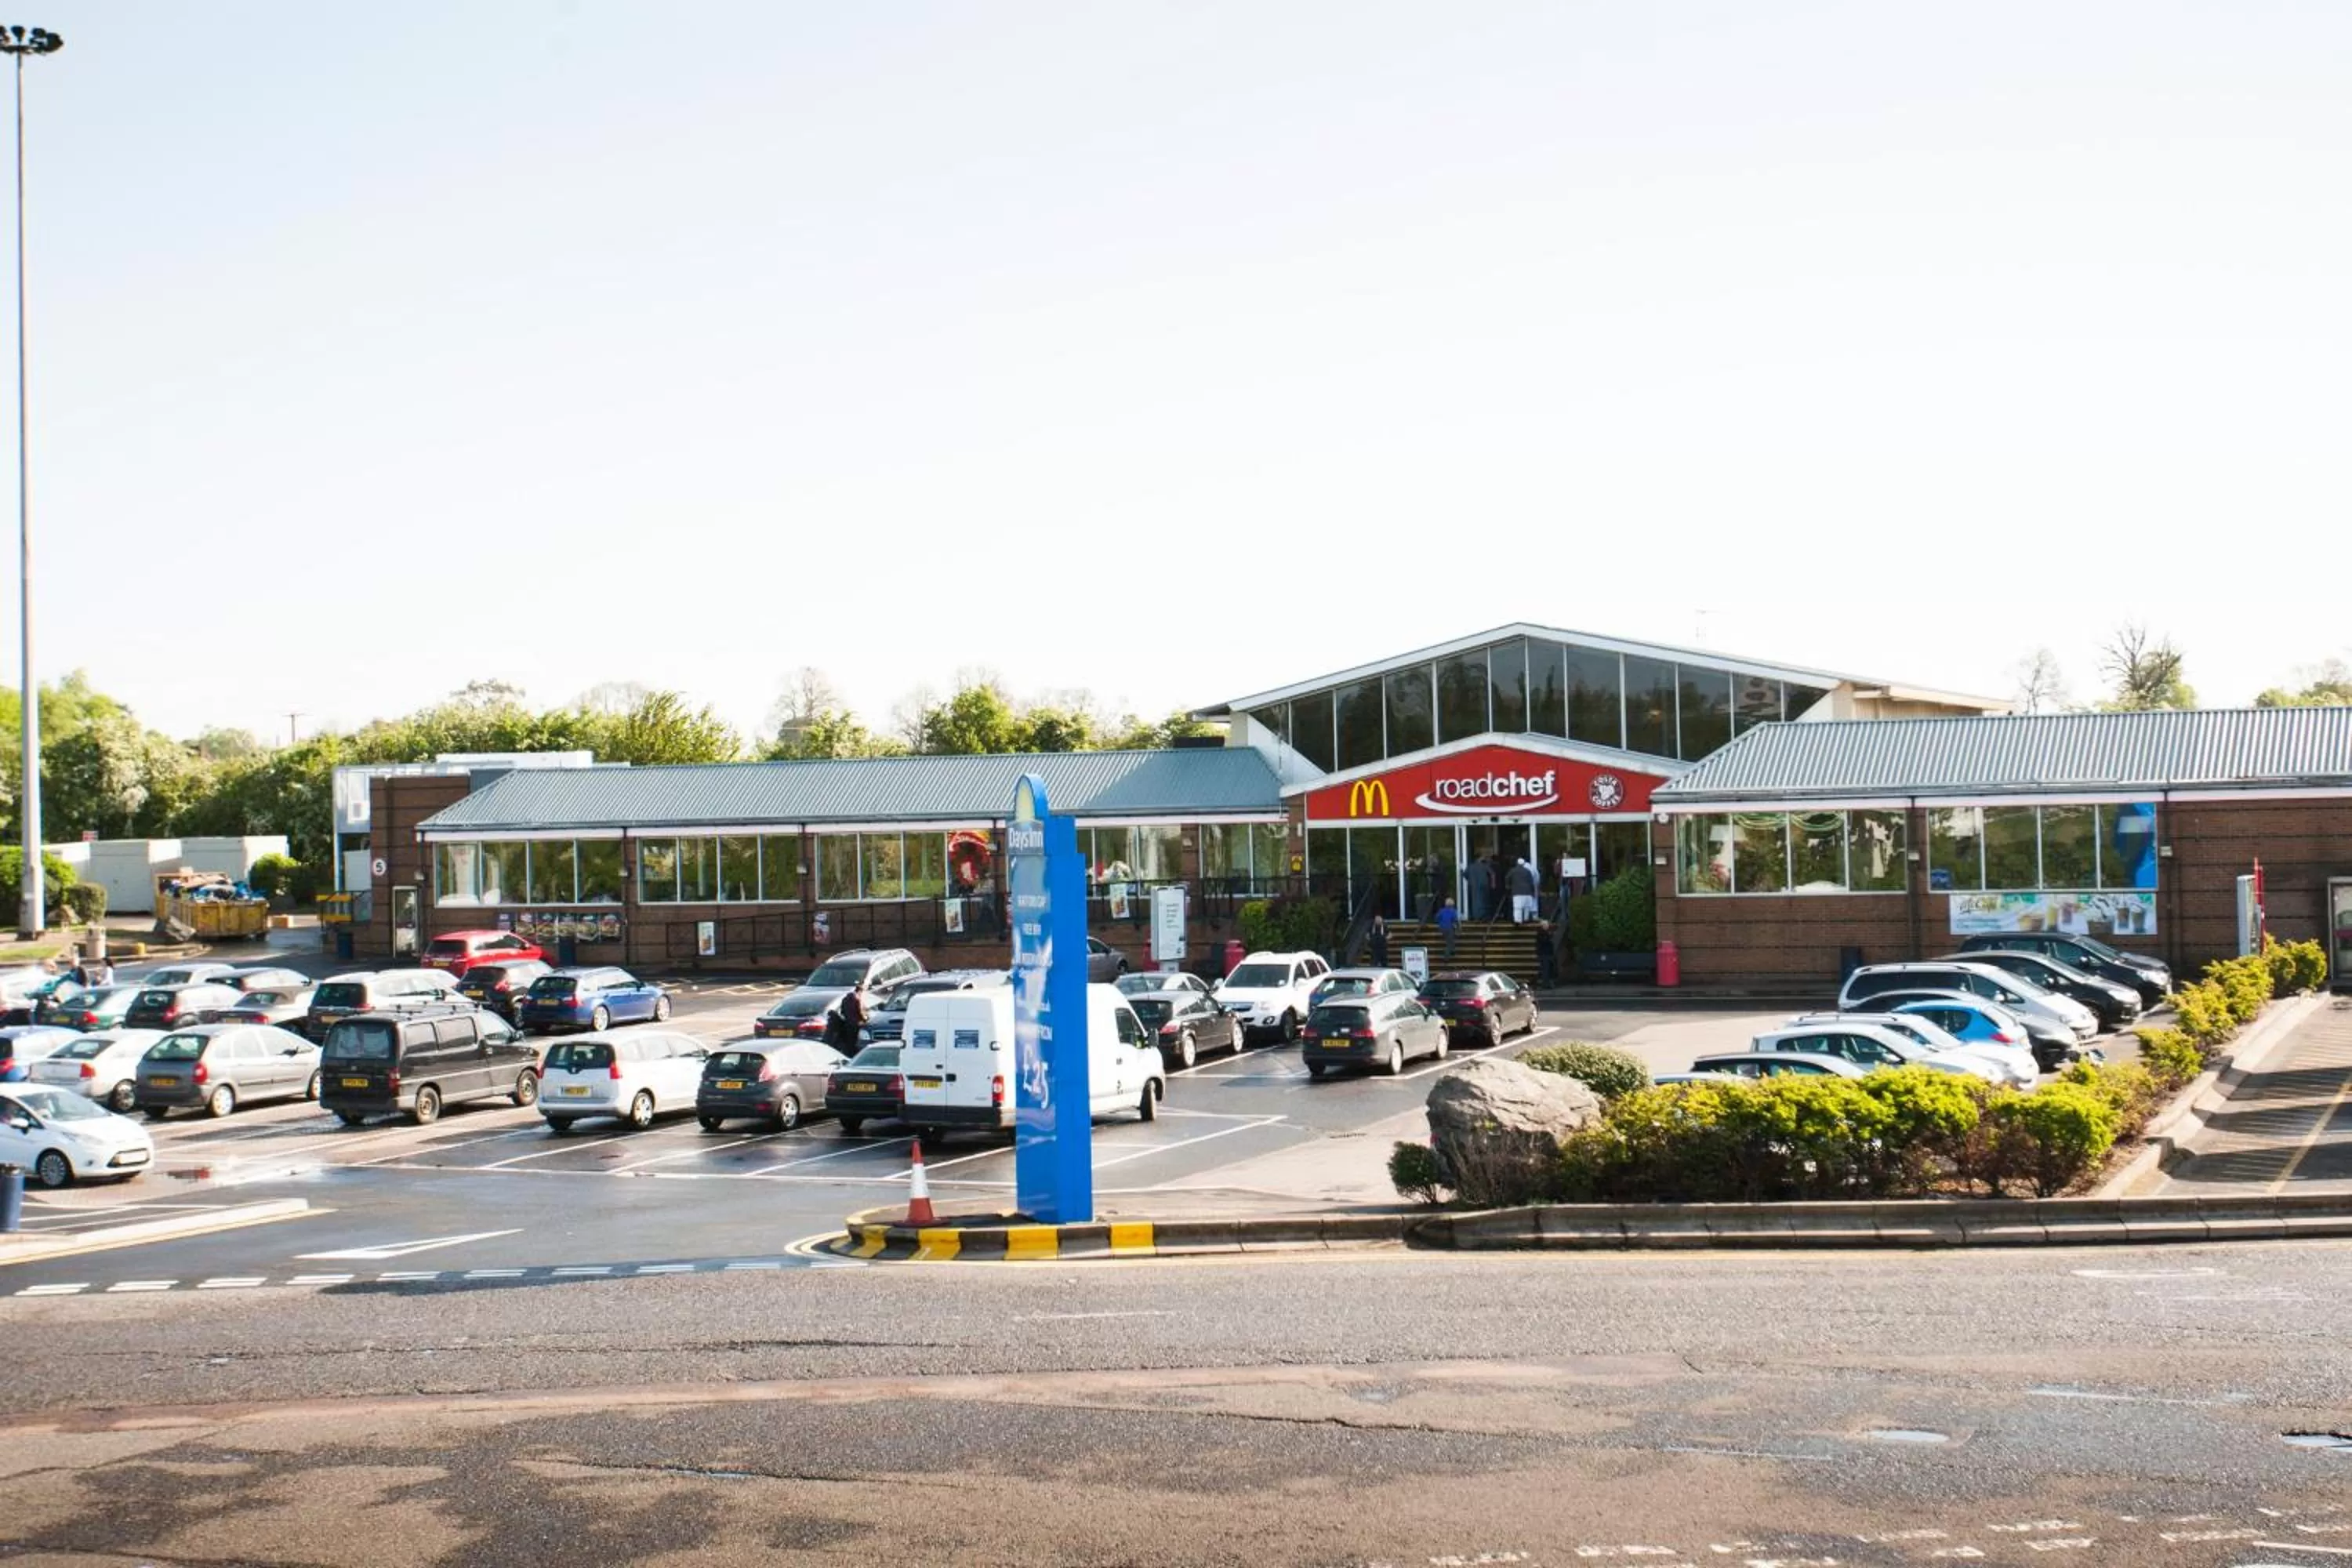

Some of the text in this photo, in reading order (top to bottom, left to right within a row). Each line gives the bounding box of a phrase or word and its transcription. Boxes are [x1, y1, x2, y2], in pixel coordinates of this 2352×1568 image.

[1436, 771, 1555, 798] roadchef
[1008, 827, 1029, 851] Days
[376, 862, 383, 873] 5
[1024, 1044, 1049, 1109] £25
